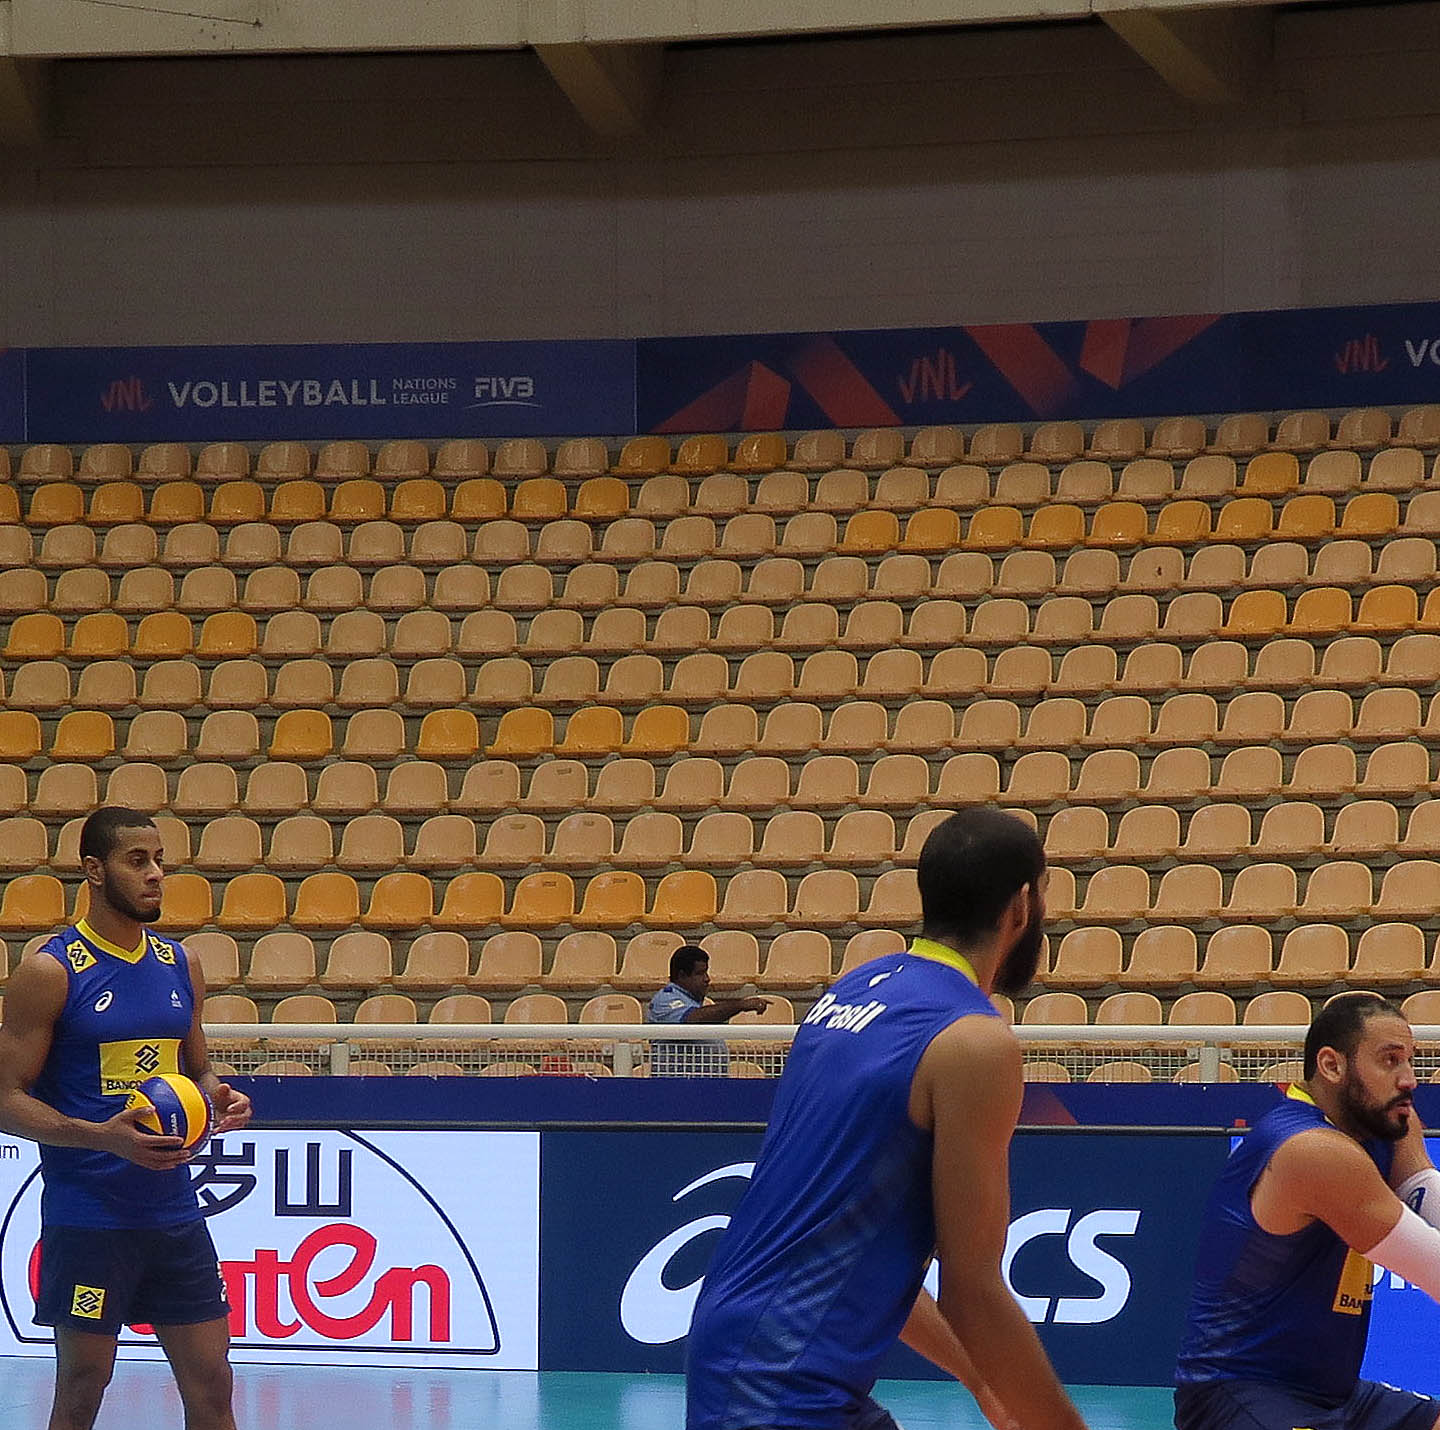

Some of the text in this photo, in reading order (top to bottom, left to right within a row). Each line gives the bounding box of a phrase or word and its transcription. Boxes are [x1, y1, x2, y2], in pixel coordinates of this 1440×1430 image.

[167, 379, 387, 408] VOLLEYBALL
[393, 377, 457, 391] NATIONS
[474, 376, 534, 399] FIVB
[393, 391, 449, 405] LEAGUE
[803, 992, 888, 1033] Brasil
